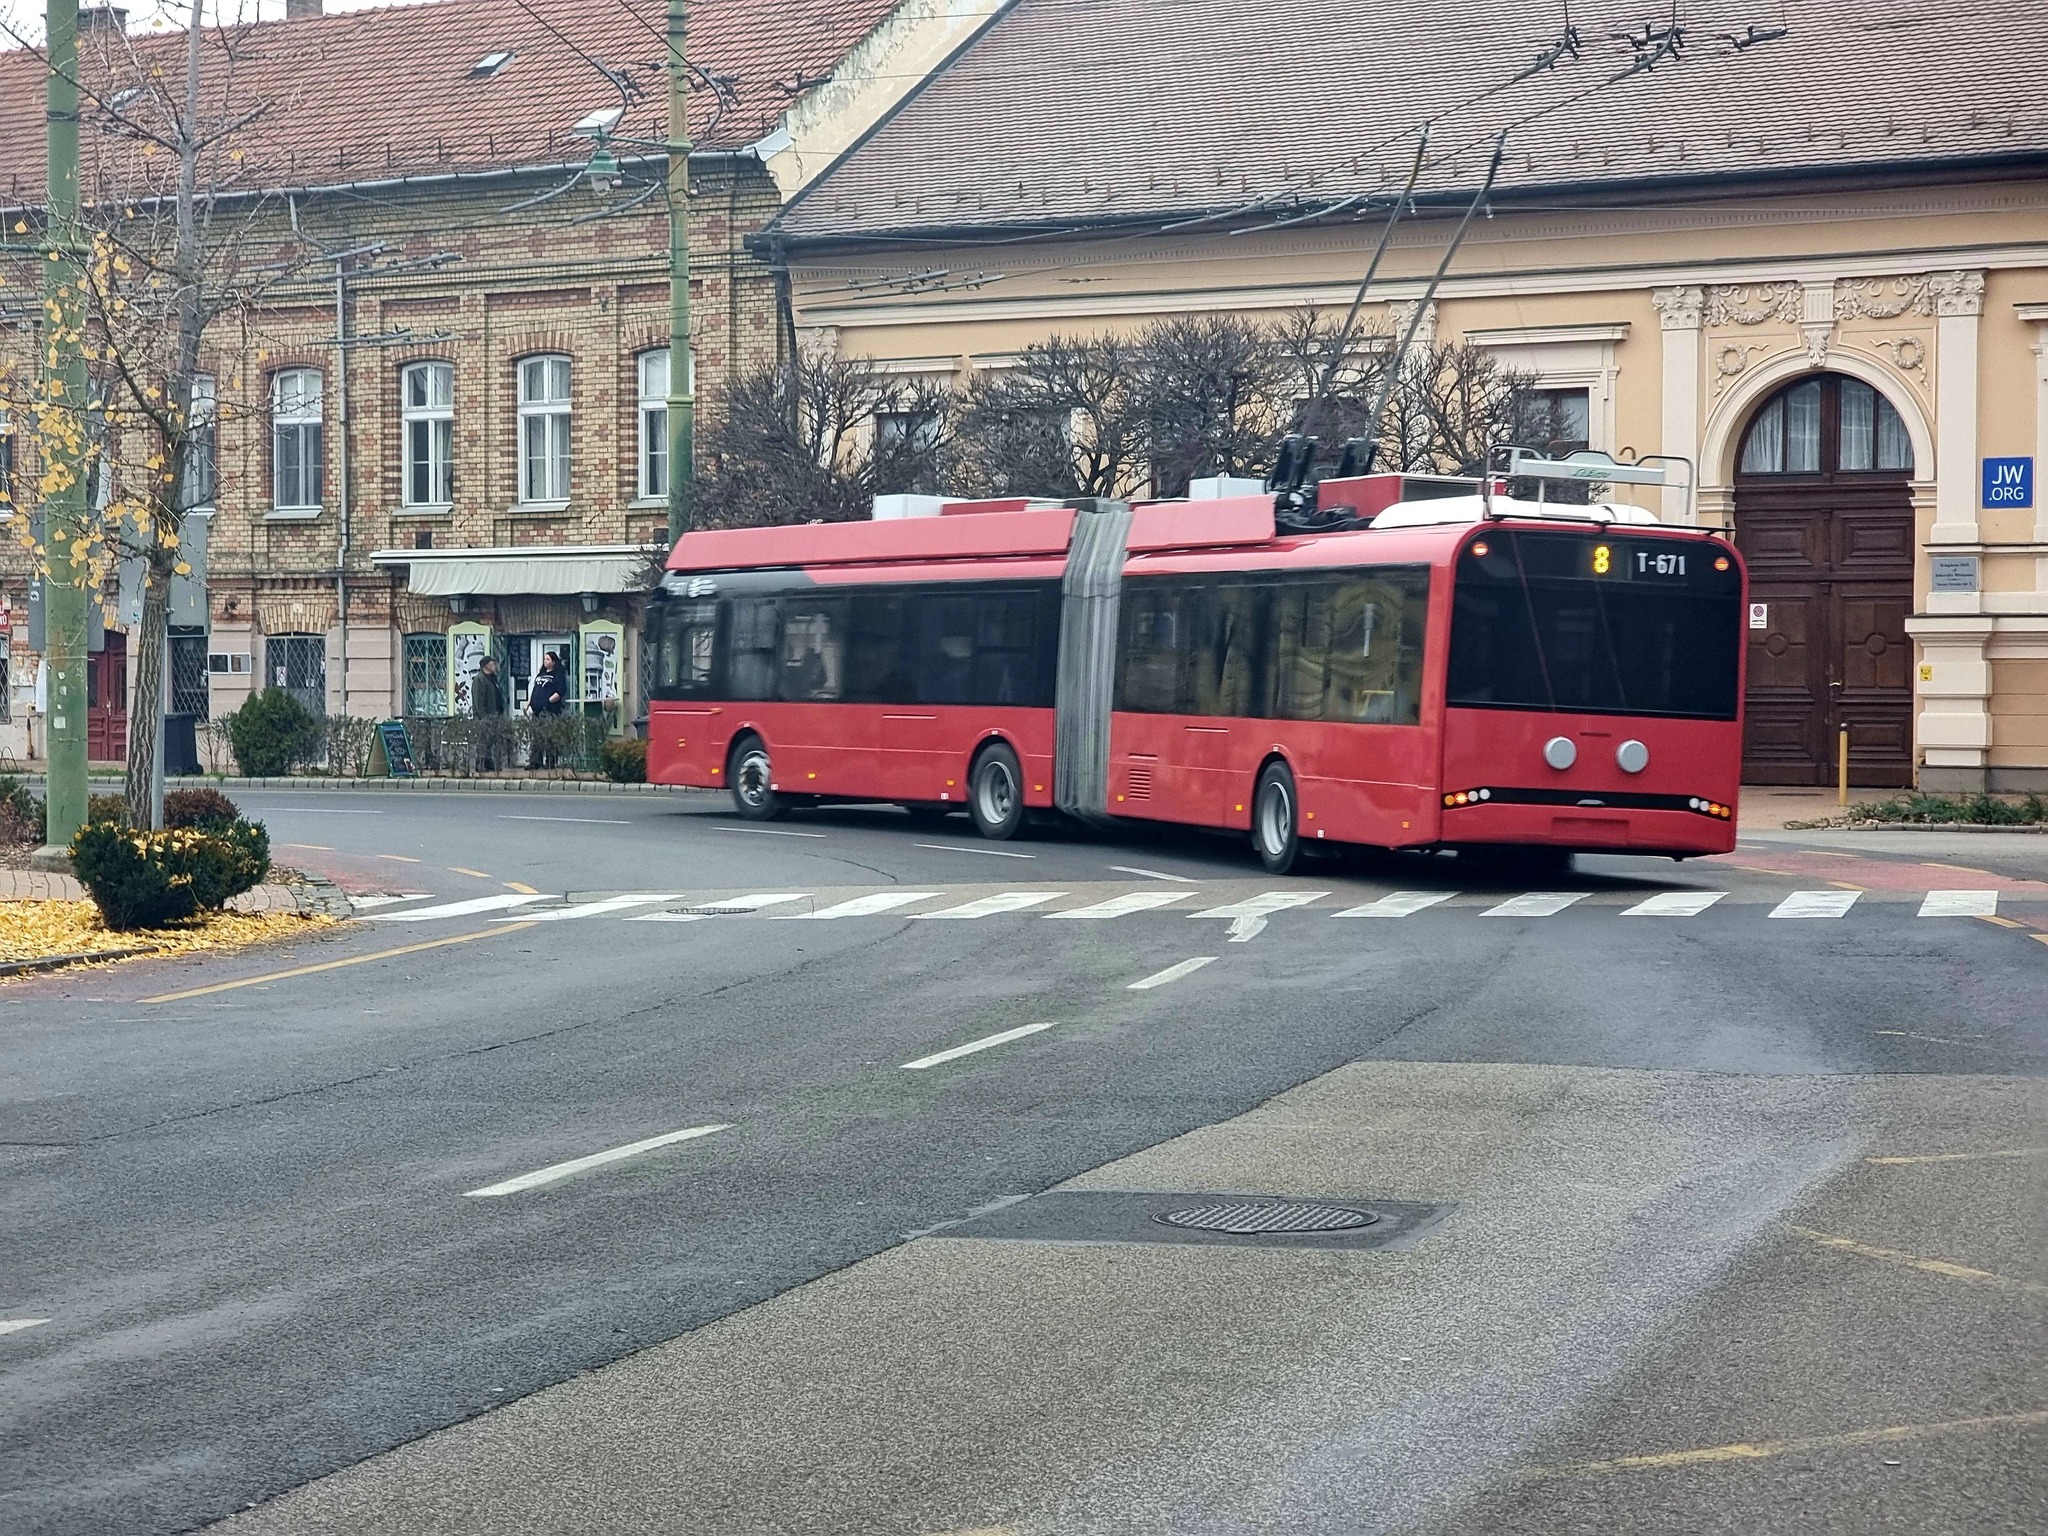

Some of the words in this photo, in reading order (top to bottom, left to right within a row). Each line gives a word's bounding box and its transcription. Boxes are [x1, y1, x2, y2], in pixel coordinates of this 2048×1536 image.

[1992, 464, 2024, 485] JW
[1989, 486, 2024, 501] .ORG
[1593, 545, 1611, 574] 8
[1636, 552, 1687, 575] T-671
